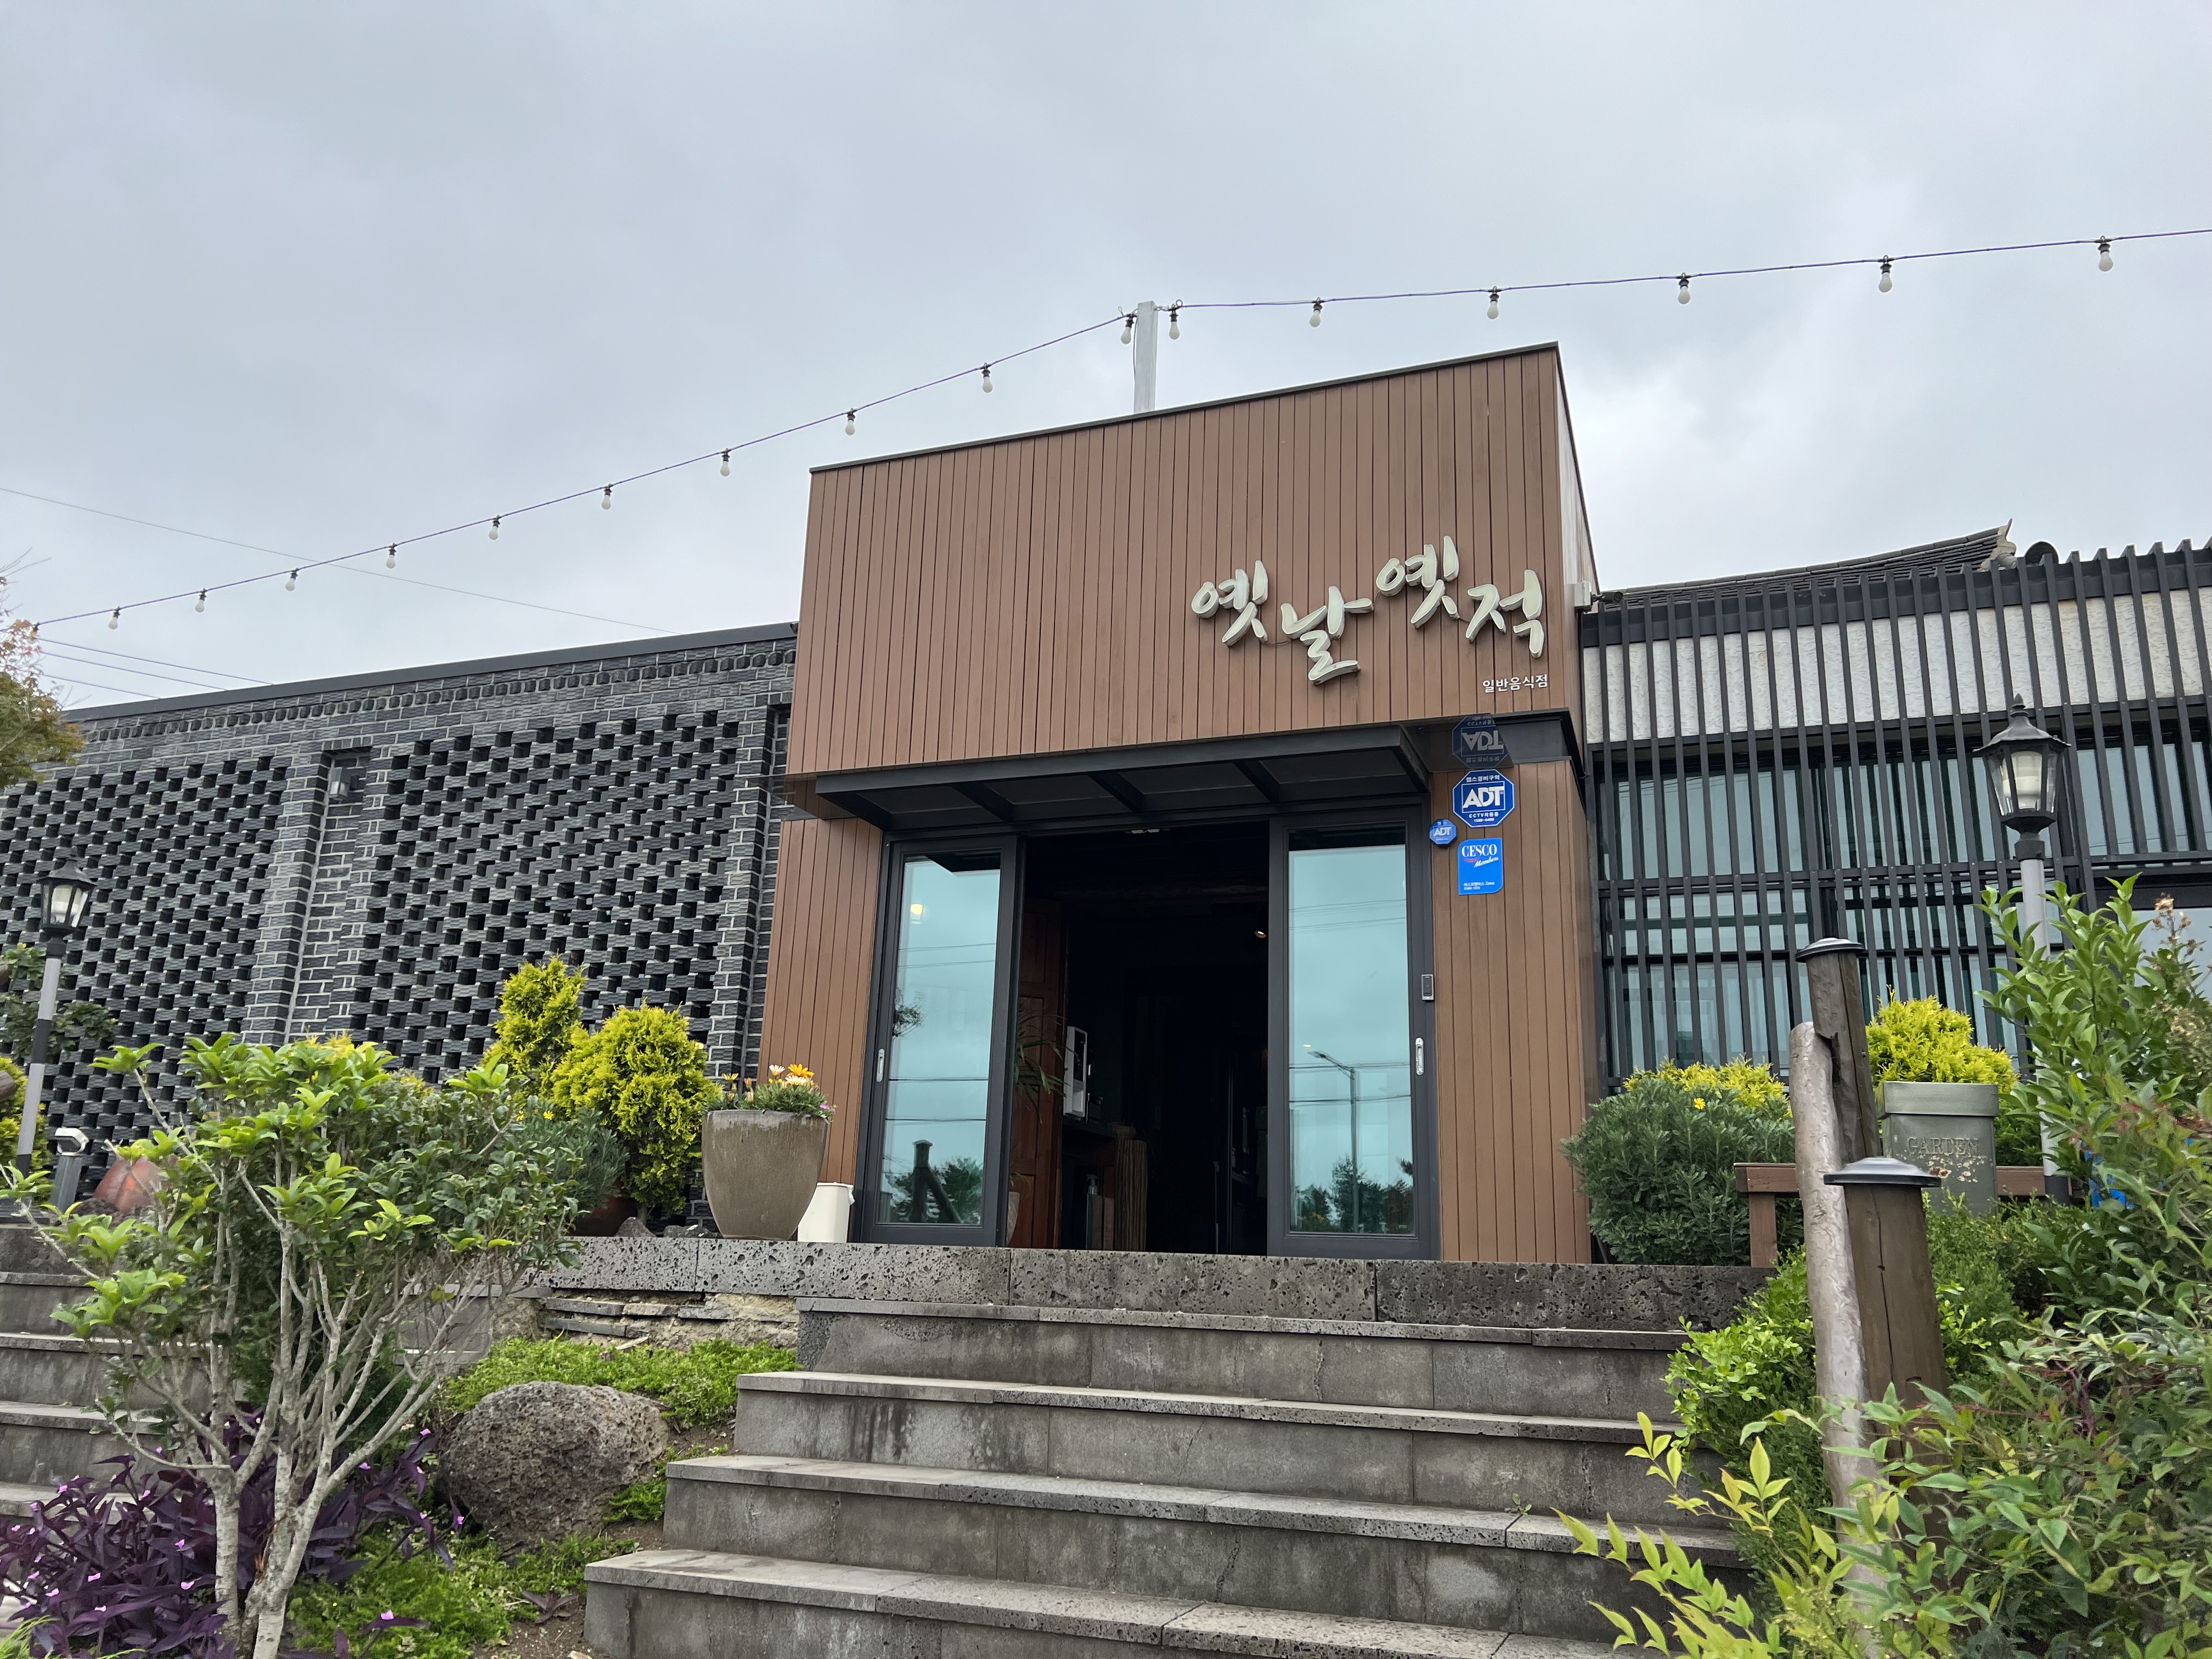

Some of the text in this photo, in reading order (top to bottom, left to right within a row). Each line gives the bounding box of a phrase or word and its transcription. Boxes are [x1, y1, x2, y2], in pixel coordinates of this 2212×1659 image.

[1482, 674, 1548, 693] 일반음식점
[1462, 786, 1505, 808] ADT
[1433, 827, 1452, 837] ADT
[1462, 844, 1497, 857] CESCO
[1474, 856, 1499, 868] Members
[1906, 1137, 1979, 1155] GARDEN
